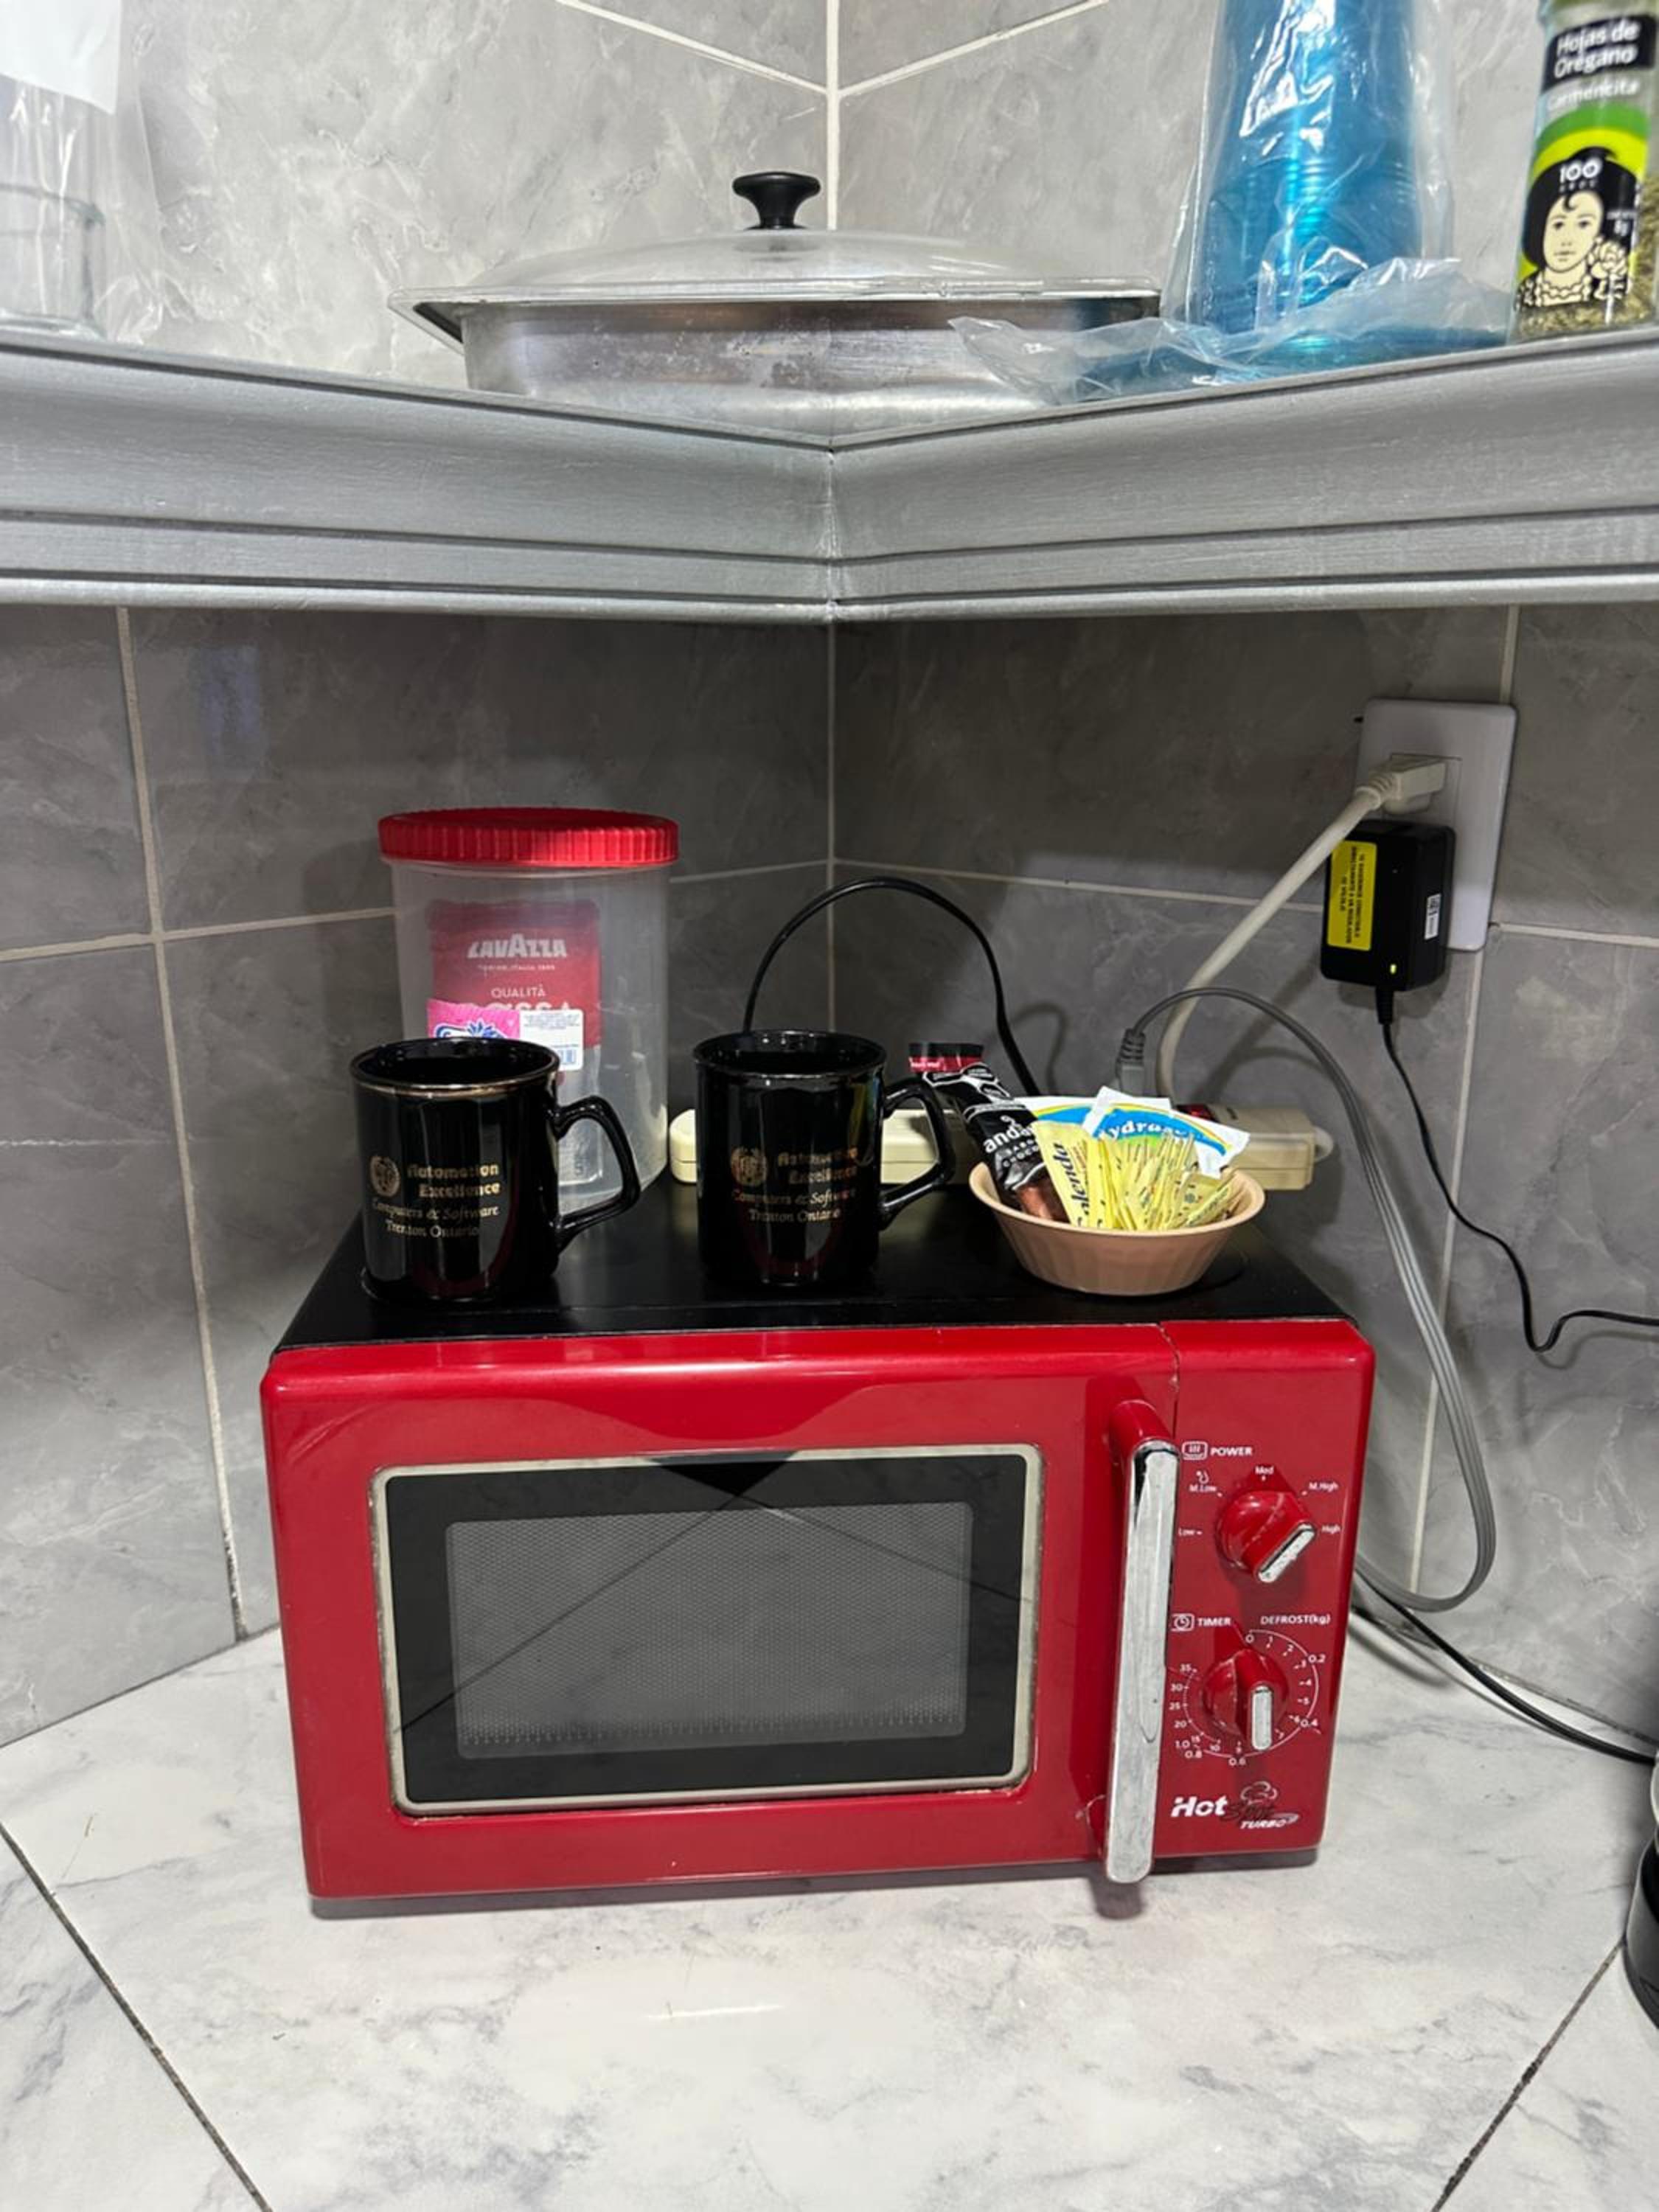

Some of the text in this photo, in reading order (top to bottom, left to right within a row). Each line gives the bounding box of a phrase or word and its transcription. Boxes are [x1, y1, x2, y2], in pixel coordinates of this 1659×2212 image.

[1557, 18, 1640, 57] Hojas de
[1559, 157, 1602, 184] 100
[467, 933, 567, 958] LAVAZZA
[490, 984, 546, 998] QUALITÀ
[407, 1163, 499, 1179] Automation
[1054, 1143, 1090, 1215] lenda
[419, 1182, 501, 1198] Excellence
[426, 1208, 439, 1220] &
[443, 1205, 499, 1221] Software
[1210, 1447, 1253, 1456] POWER
[1256, 1466, 1274, 1475] Med
[1178, 1528, 1196, 1537] Low
[1321, 1524, 1341, 1535] High
[1197, 1617, 1231, 1627] TIMER
[1308, 1654, 1326, 1663] 0.2
[1175, 1719, 1187, 1729] 20
[1301, 1719, 1318, 1728] 0.4
[1184, 1750, 1203, 1759] 0.8
[1228, 1756, 1246, 1767] 0.6
[1170, 1795, 1228, 1818] Hot
[1240, 1819, 1287, 1829] TURBO
